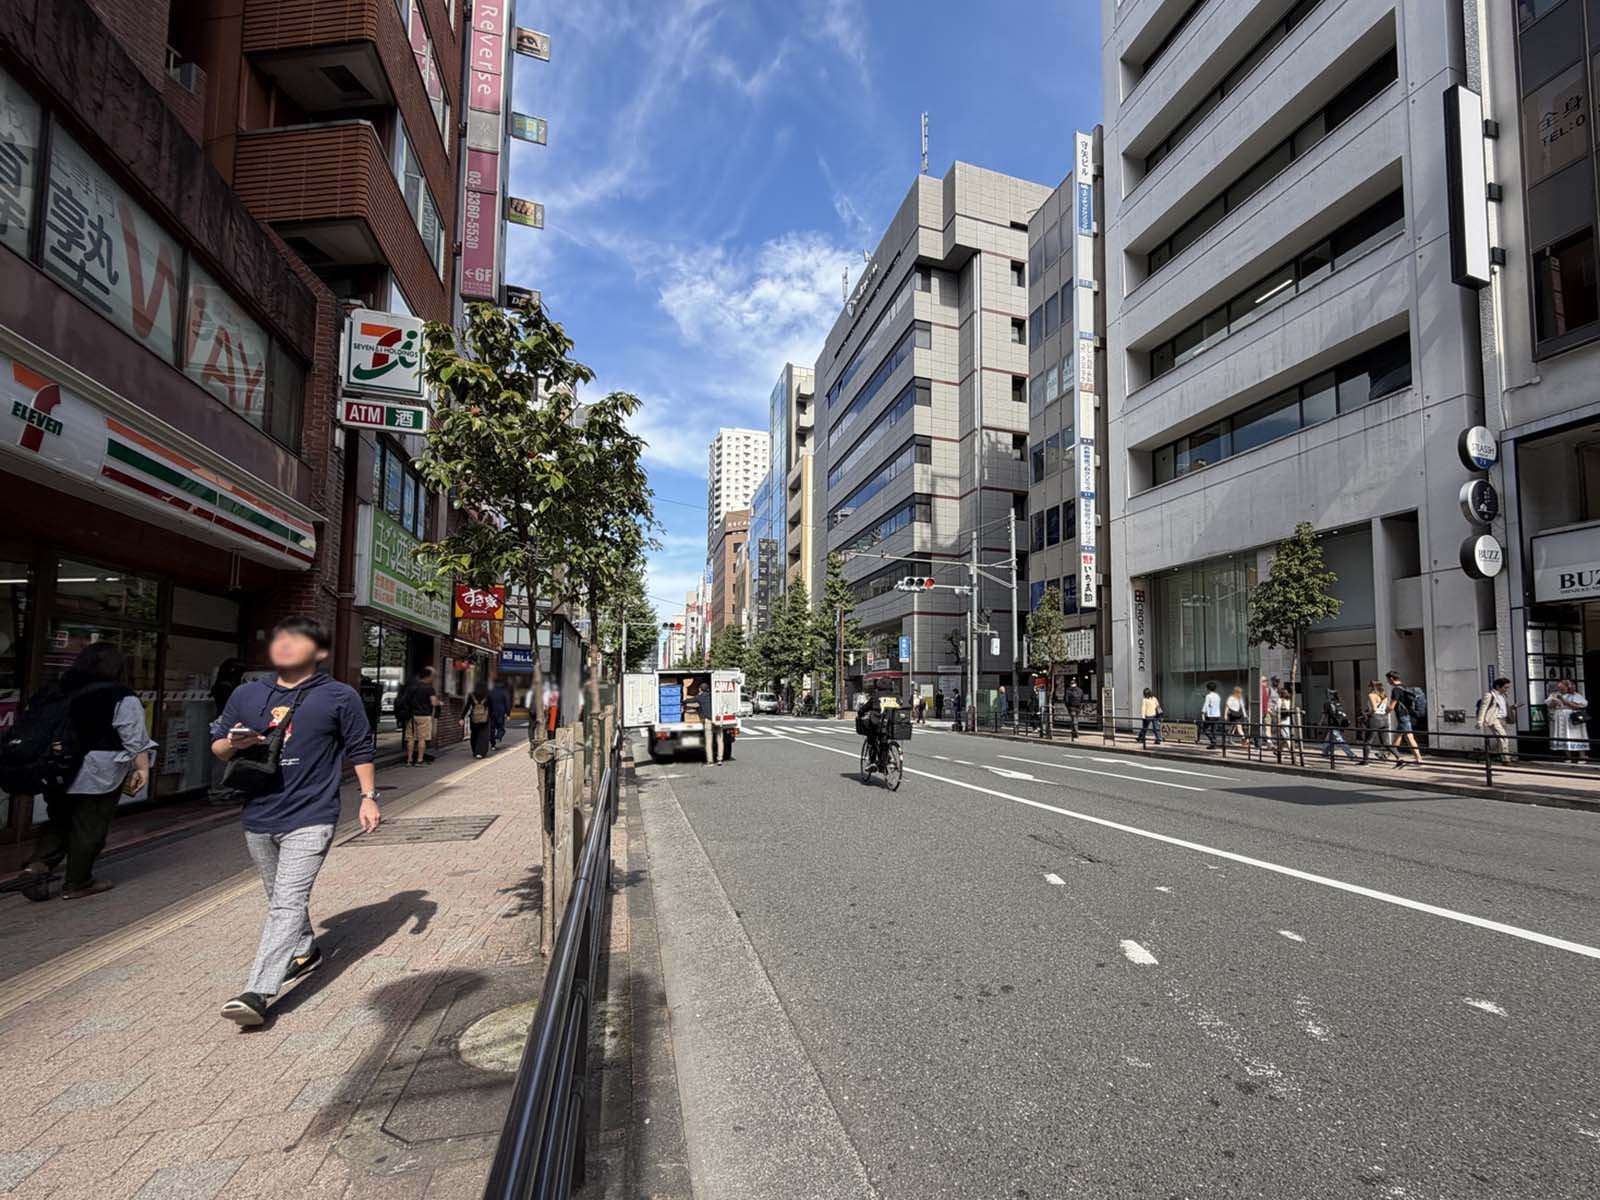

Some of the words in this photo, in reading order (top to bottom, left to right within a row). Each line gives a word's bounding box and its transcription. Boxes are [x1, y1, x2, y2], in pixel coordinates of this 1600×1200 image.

[477, 4, 498, 96] Reverse
[466, 171, 482, 249] 03-3360-5530
[475, 267, 492, 283] 6F
[353, 342, 375, 351] SEVEN
[384, 347, 418, 358] HOLDINGS
[349, 404, 381, 424] ATM
[395, 409, 415, 427] 酒
[1478, 549, 1500, 561] BUZZ
[461, 587, 498, 610] すき家
[1135, 602, 1145, 636] CROSS
[1137, 638, 1146, 672] OFFICE
